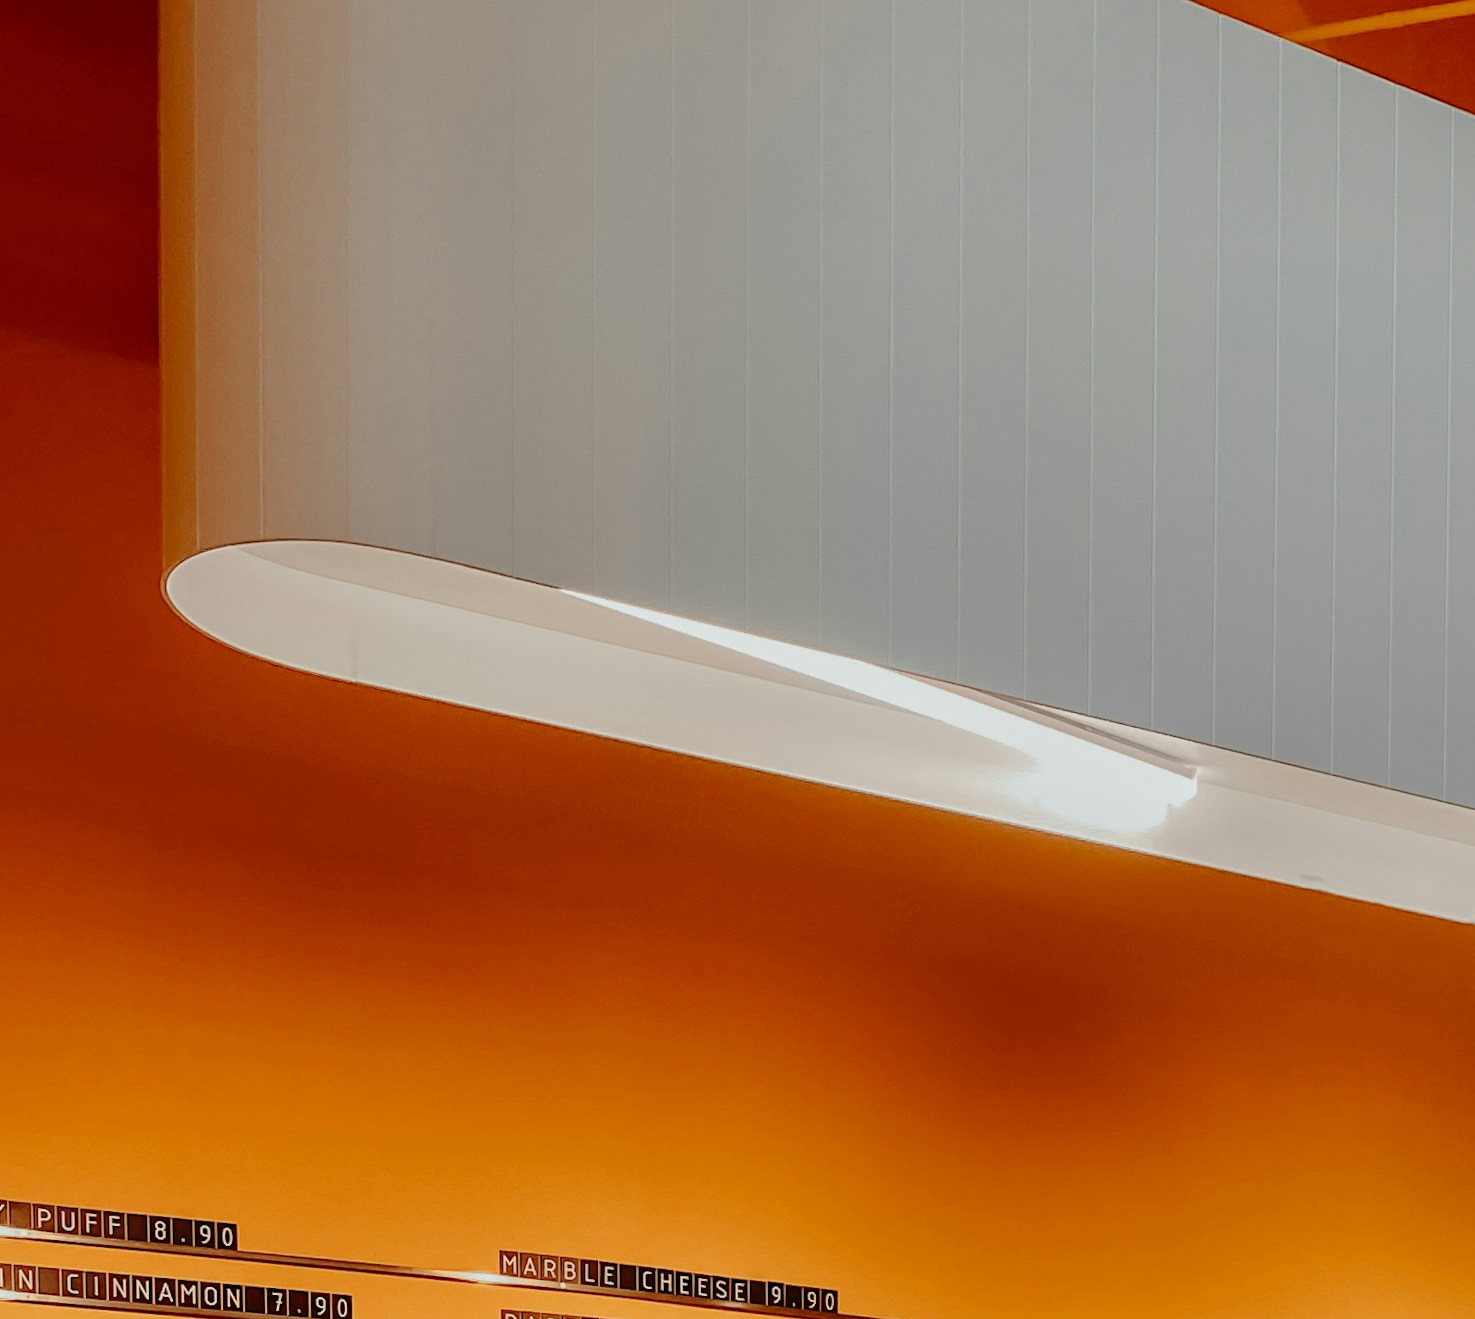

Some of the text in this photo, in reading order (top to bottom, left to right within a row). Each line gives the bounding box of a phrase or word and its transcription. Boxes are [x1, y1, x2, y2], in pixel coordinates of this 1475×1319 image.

[36, 1207, 122, 1235] PUFF
[154, 1220, 234, 1247] 8.90
[65, 1272, 241, 1309] CINNAMON
[271, 1291, 349, 1318] 7.90
[503, 1254, 836, 1312] MARBLE CHEESE 9.90
